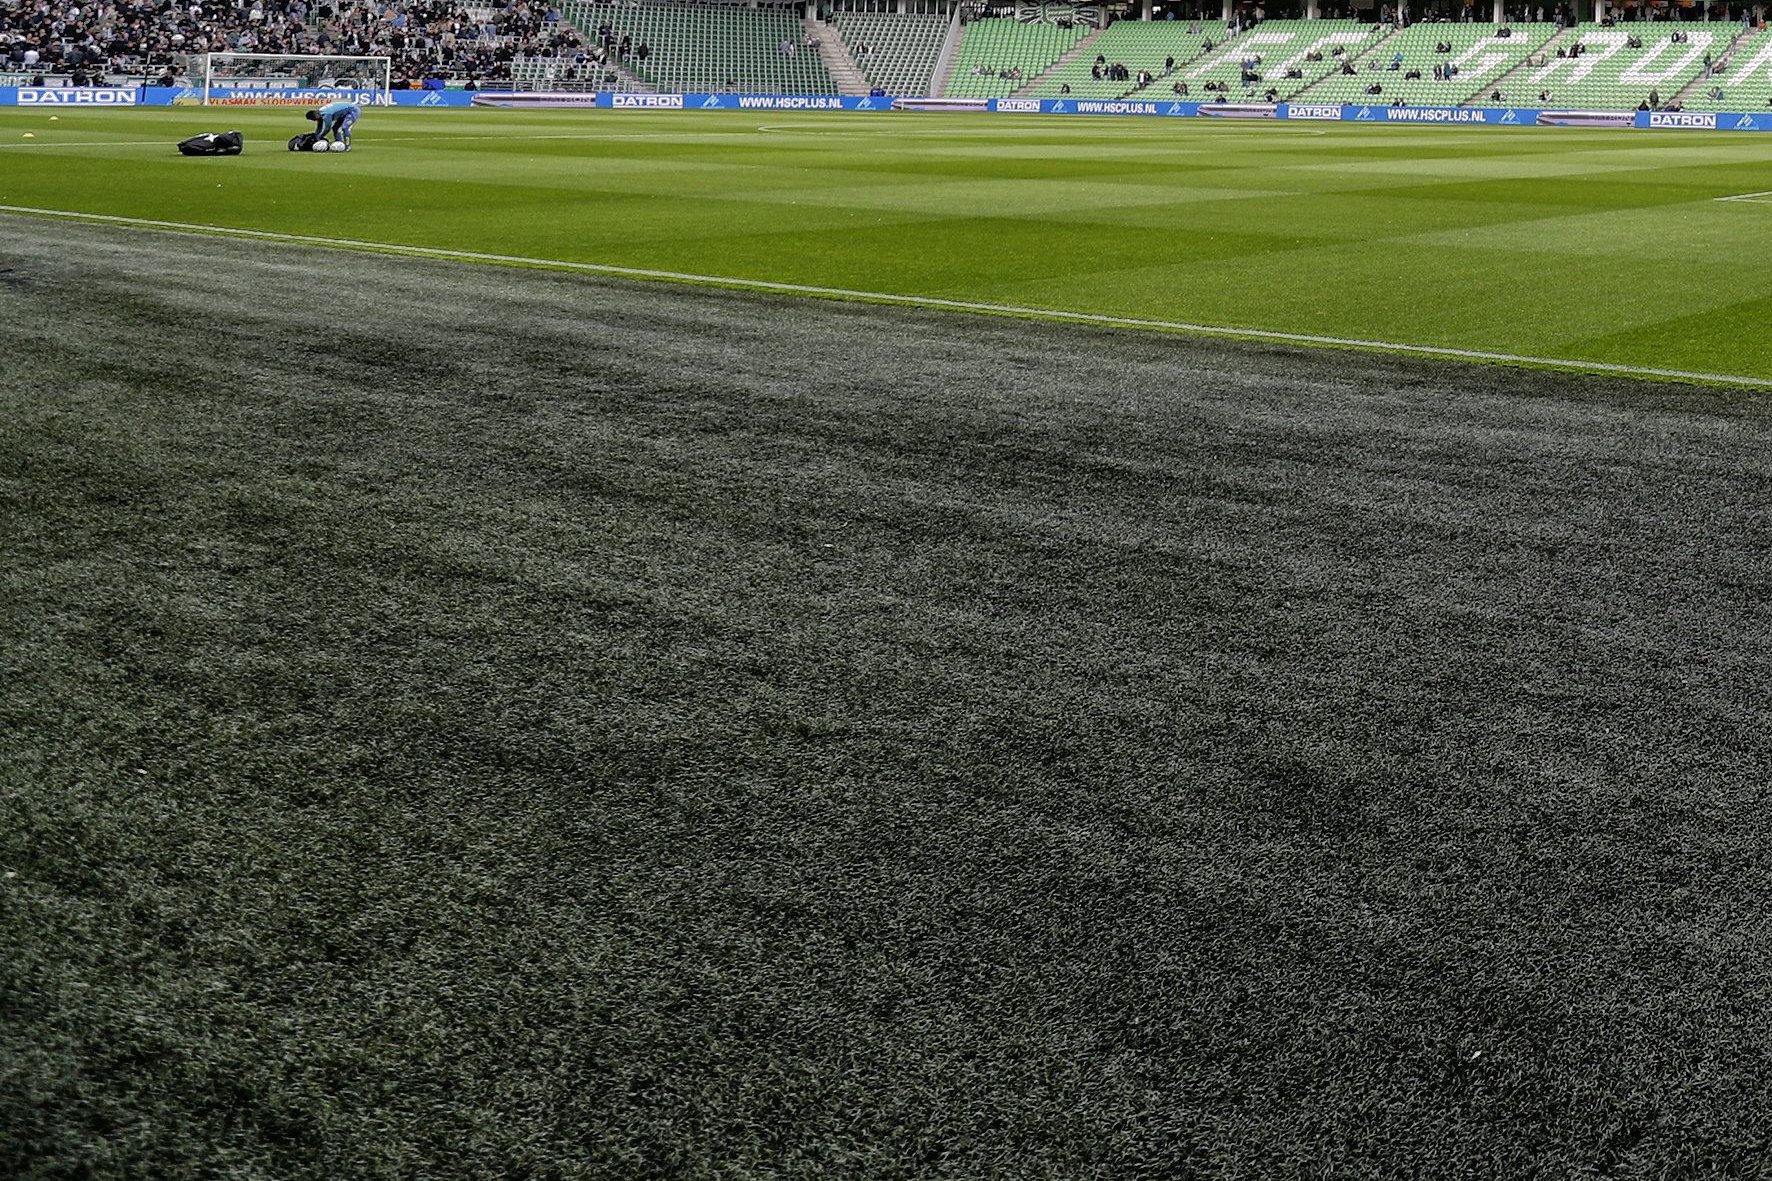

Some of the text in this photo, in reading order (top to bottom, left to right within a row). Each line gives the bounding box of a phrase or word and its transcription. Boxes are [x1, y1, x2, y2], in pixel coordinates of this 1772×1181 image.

[18, 90, 136, 102] DATRON
[613, 97, 683, 106] DATRON
[739, 97, 843, 109] WWW.HSCPLUS.NL
[997, 101, 1040, 110] DATRON
[1077, 102, 1157, 113] WWW.HSCPLUS.NL
[1288, 107, 1341, 117] DATRON
[1387, 109, 1486, 122] WWW.HSCPLUS.NL
[1650, 115, 1717, 126] DATRON
